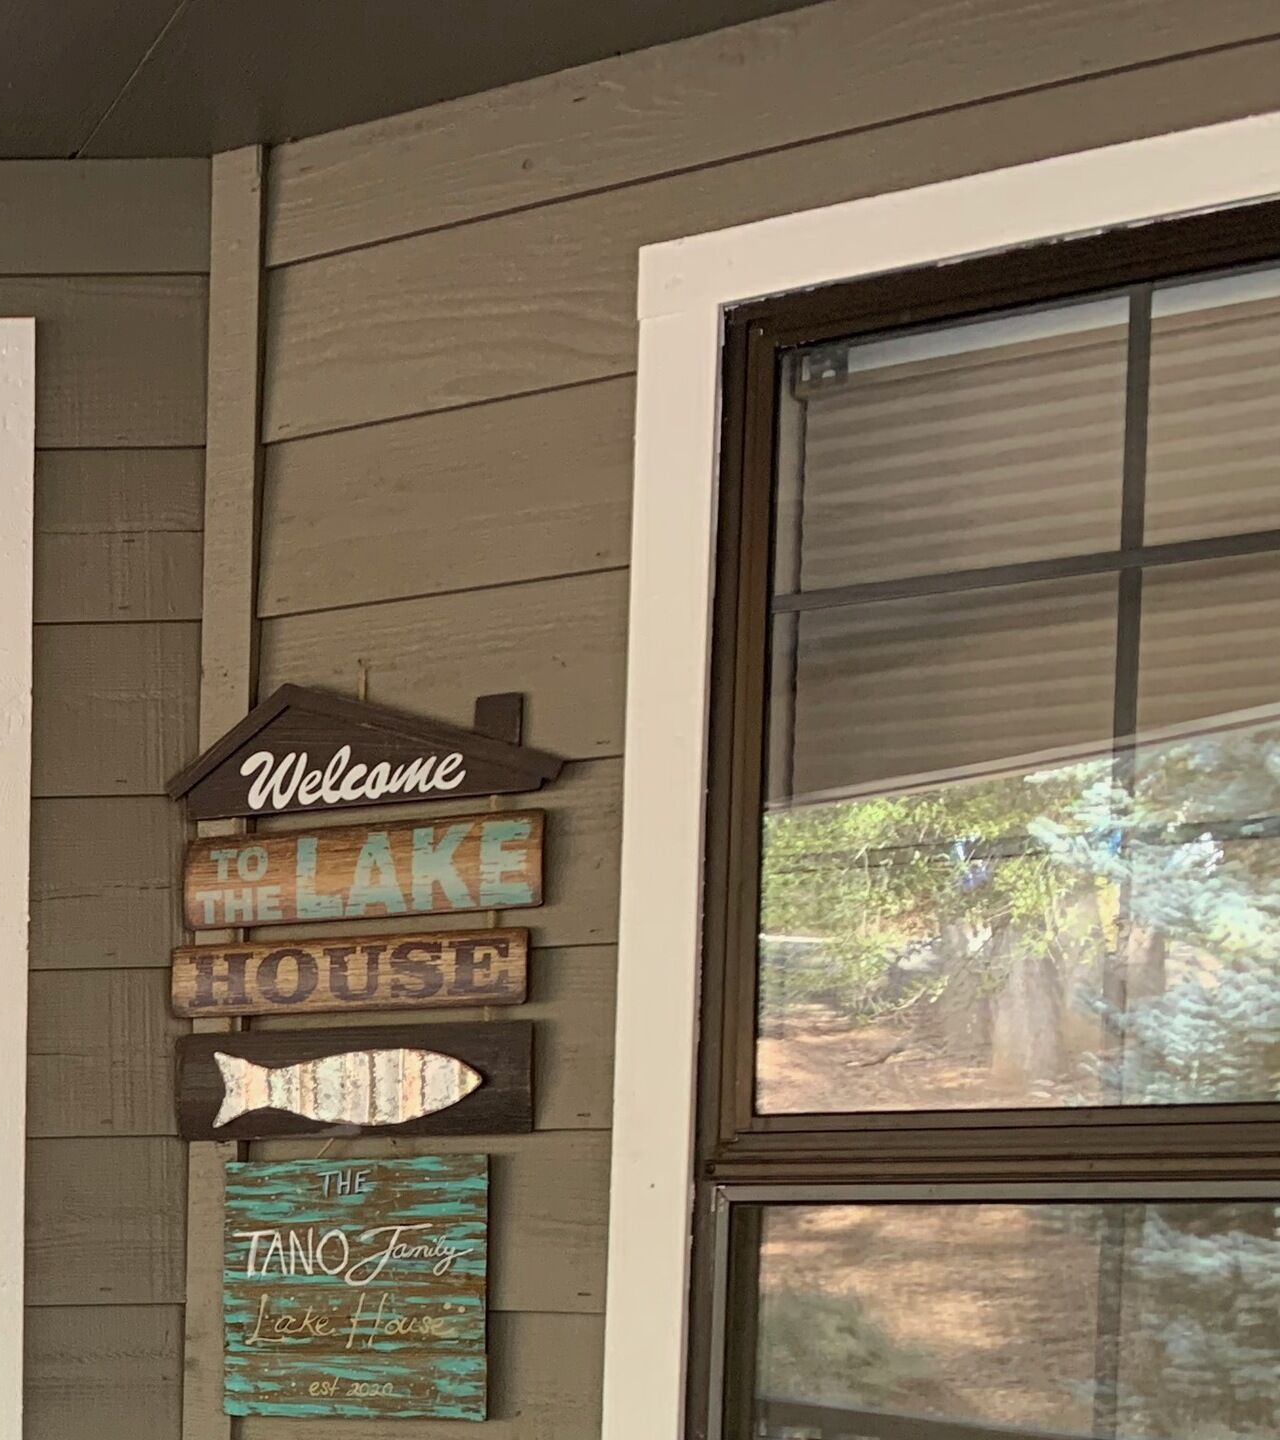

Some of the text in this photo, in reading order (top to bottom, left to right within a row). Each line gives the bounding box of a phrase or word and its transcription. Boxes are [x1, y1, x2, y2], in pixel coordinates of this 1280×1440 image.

[240, 745, 466, 810] Welcome
[210, 846, 269, 881] TO
[295, 817, 534, 919] LAKE
[196, 885, 284, 925] THE
[188, 938, 510, 1008] HOUSE
[316, 1168, 372, 1197] THE
[233, 1223, 474, 1286] TANO Family
[245, 1292, 458, 1349] Lake House
[308, 1376, 395, 1397] est 2020
